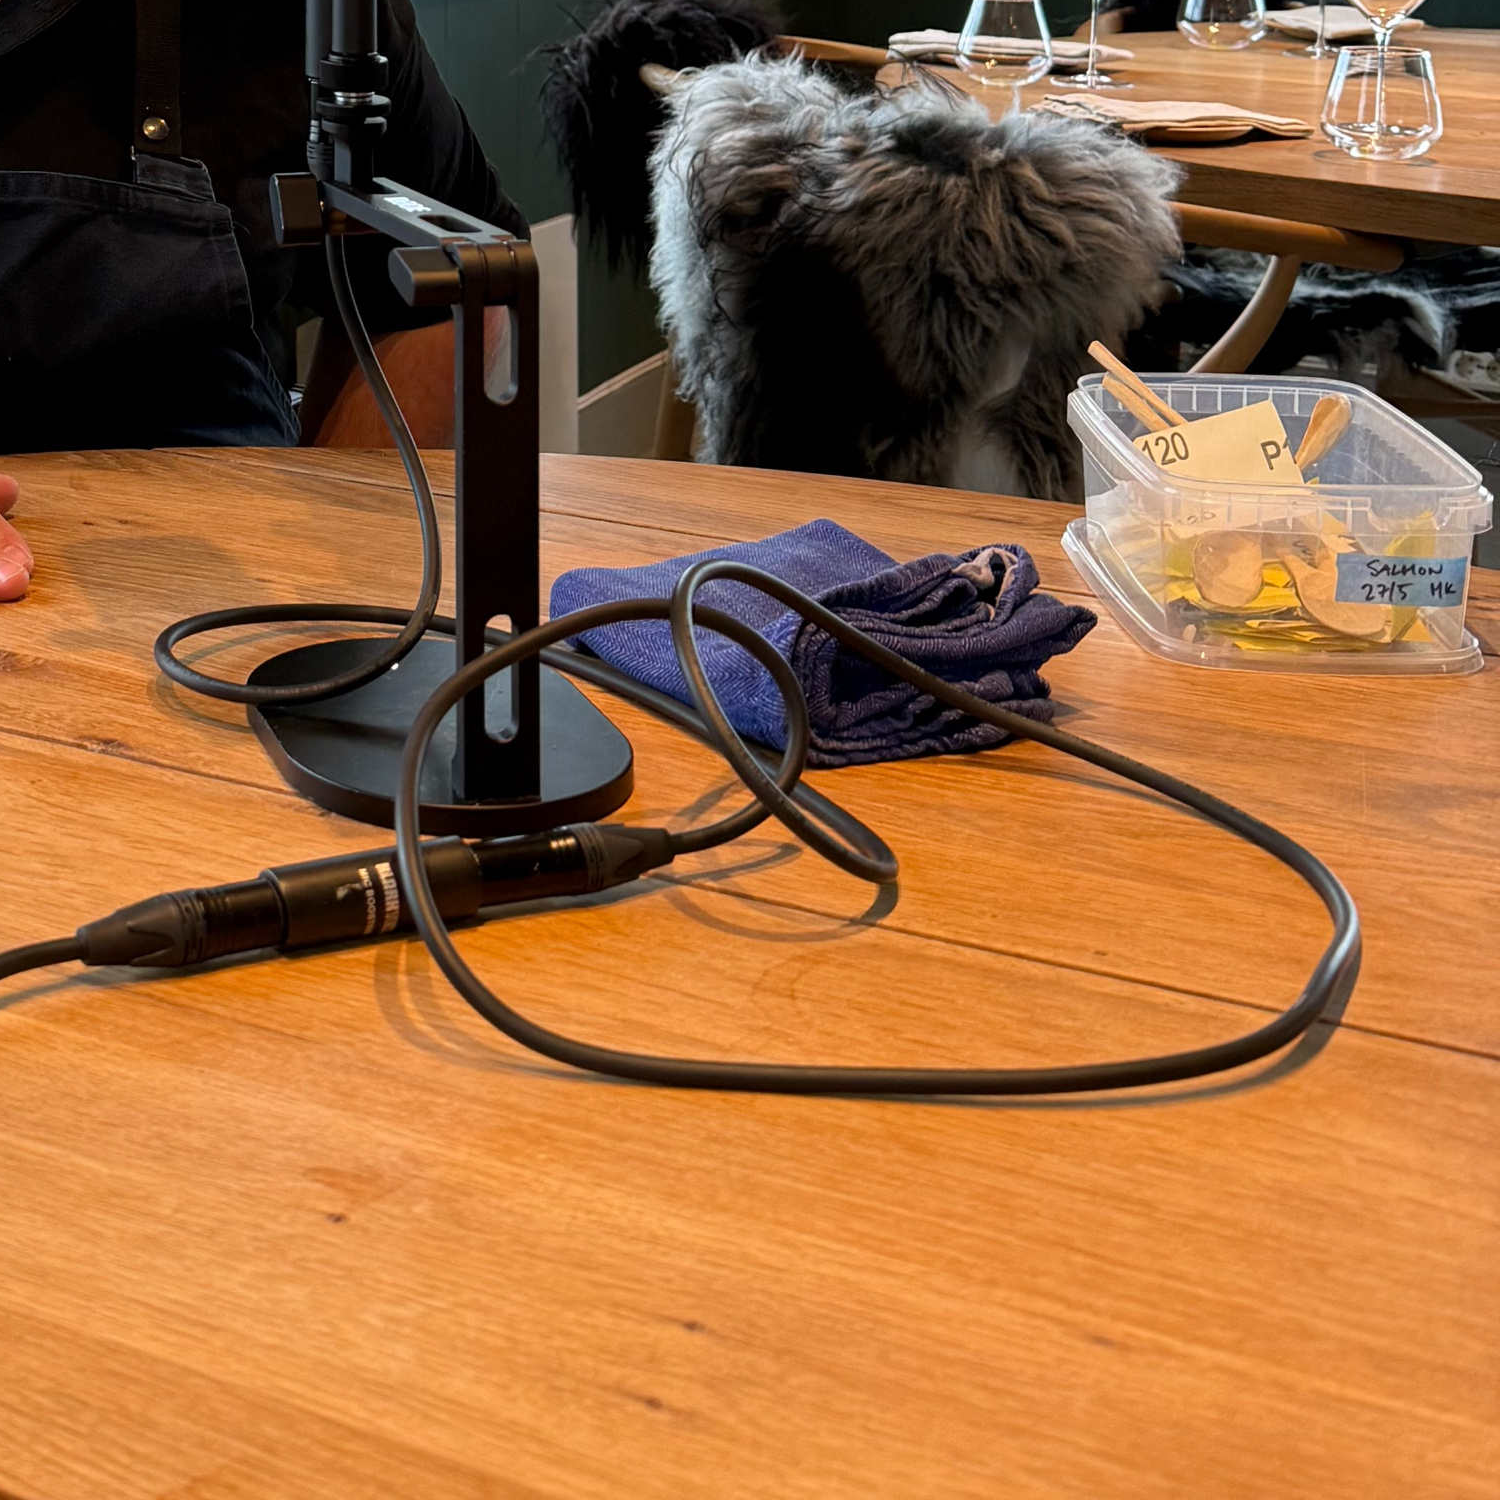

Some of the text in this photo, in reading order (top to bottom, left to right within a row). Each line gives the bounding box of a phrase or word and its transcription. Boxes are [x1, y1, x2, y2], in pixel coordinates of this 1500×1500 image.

[1141, 432, 1190, 466] 120
[1366, 559, 1443, 577] SALMON
[1361, 582, 1414, 602] 27/5
